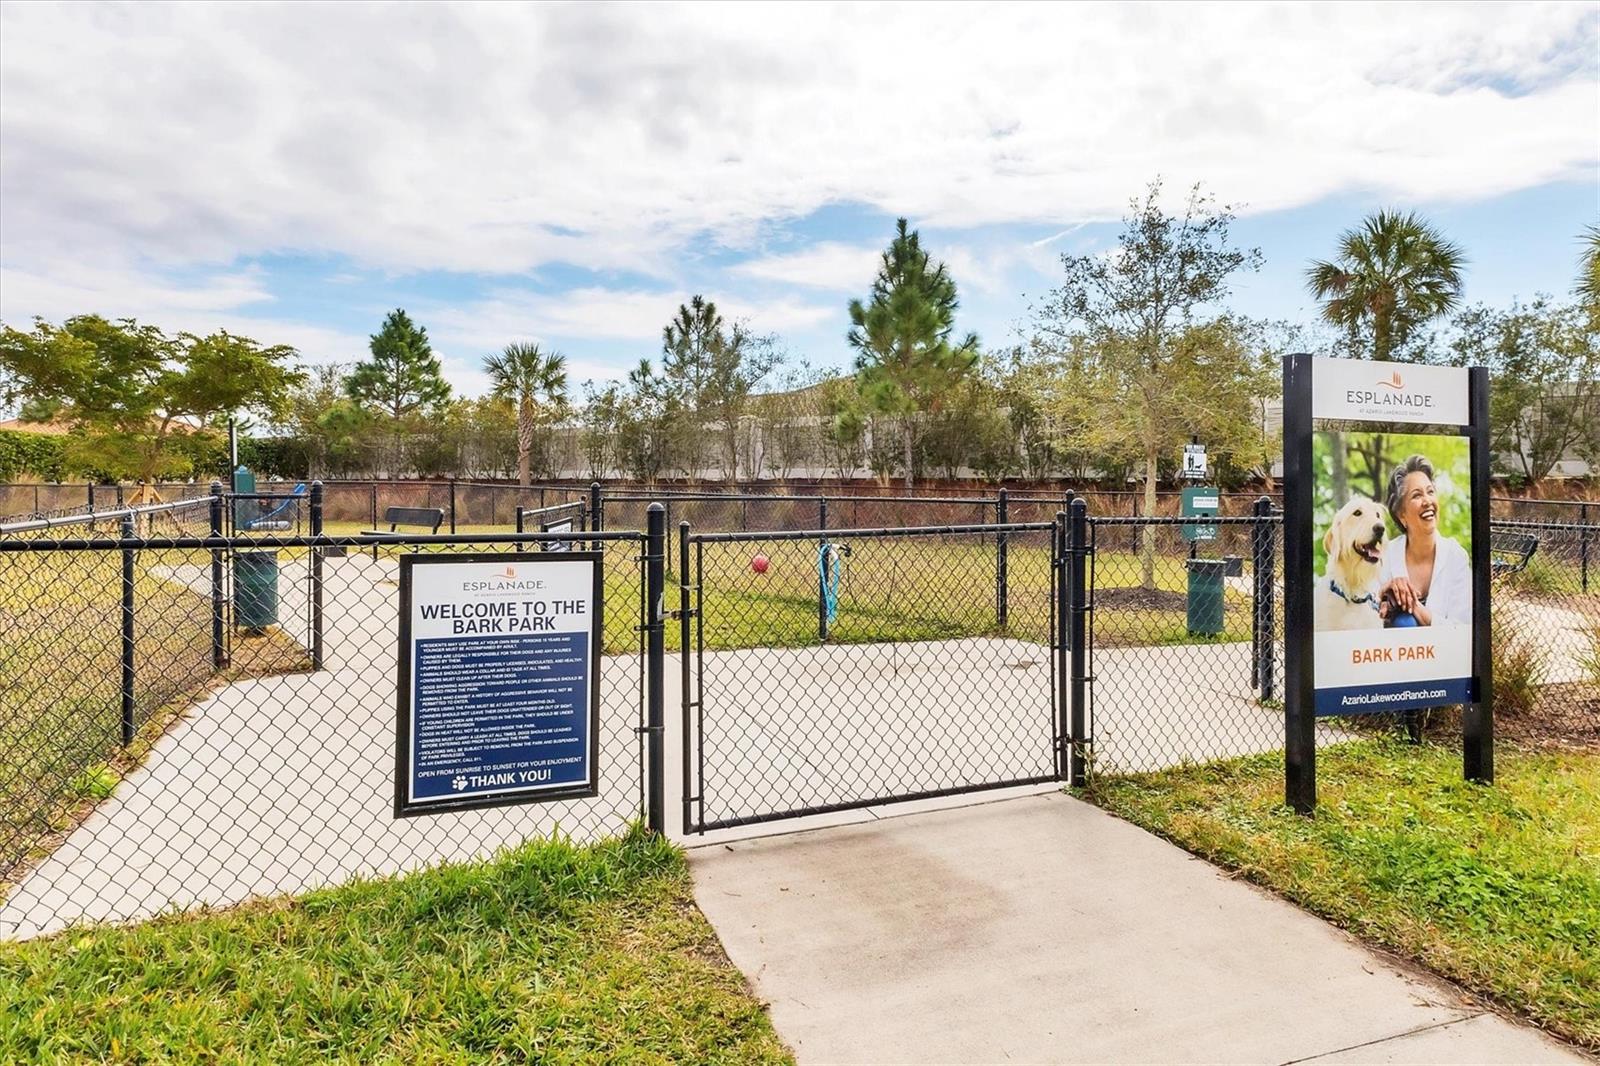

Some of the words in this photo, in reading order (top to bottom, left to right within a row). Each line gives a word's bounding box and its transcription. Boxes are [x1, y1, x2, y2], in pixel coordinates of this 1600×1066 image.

[420, 602, 518, 620] WELCOME
[522, 600, 546, 616] TO
[552, 600, 586, 614] THE
[452, 618, 502, 634] BARK
[509, 616, 556, 632] PARK
[1352, 648, 1392, 664] BARK
[1398, 646, 1434, 660] PARK
[1342, 690, 1446, 705] AzarioLakewoodRanch.com
[455, 766, 481, 774] SUNRISE
[547, 756, 582, 765] ENJOYMENT
[469, 772, 515, 787] THANK
[518, 768, 551, 782] YOU!
